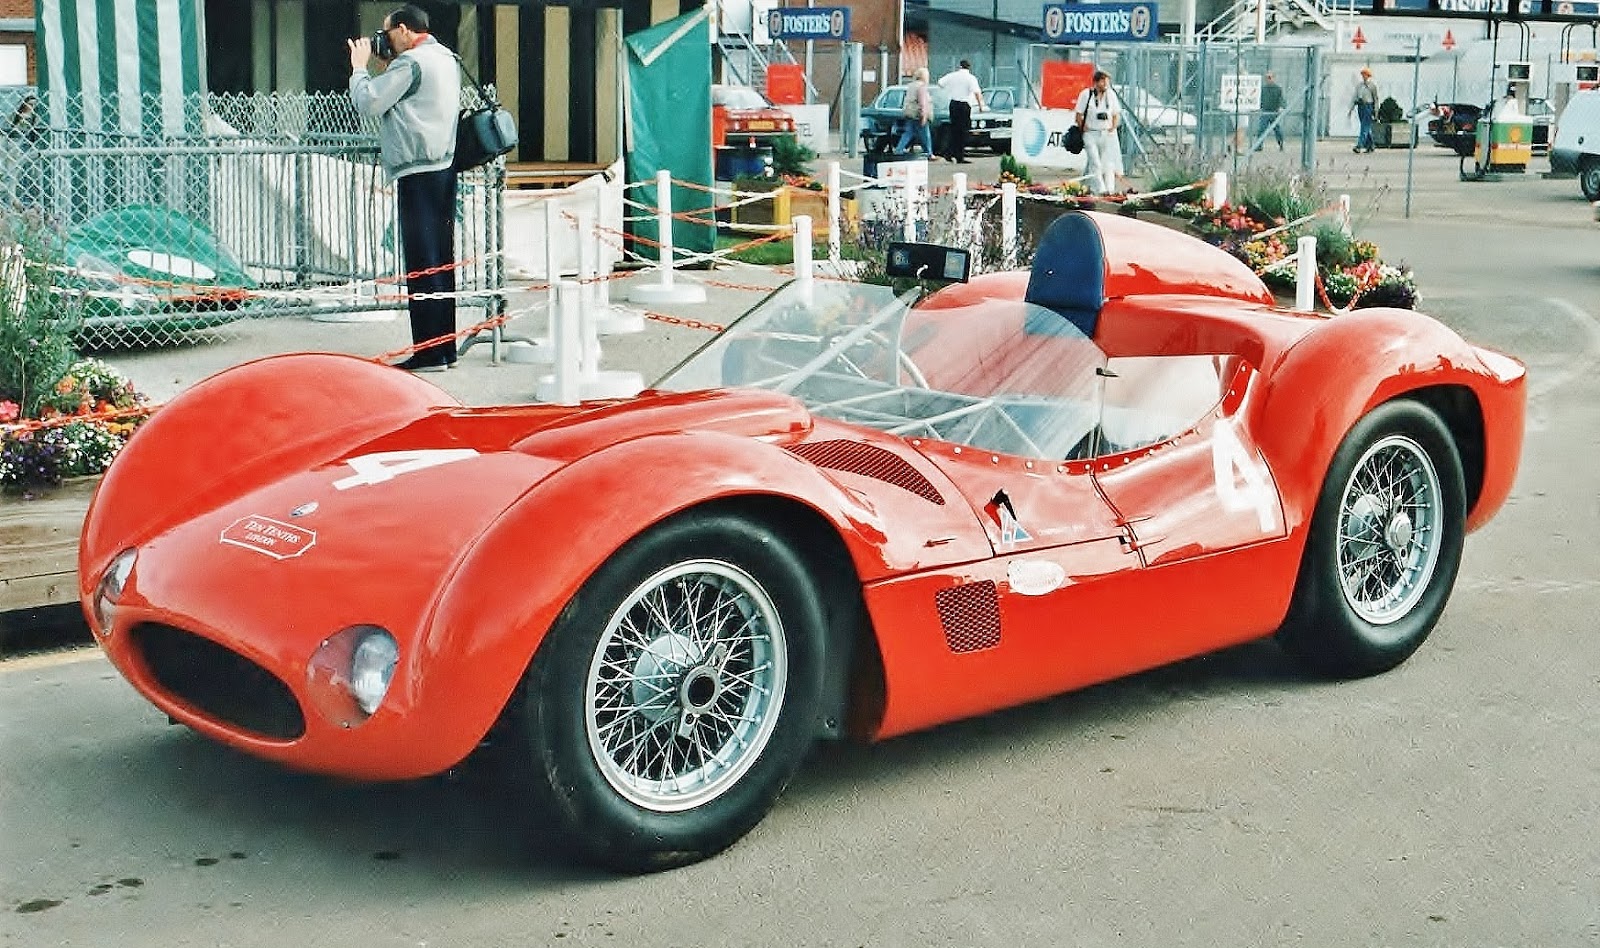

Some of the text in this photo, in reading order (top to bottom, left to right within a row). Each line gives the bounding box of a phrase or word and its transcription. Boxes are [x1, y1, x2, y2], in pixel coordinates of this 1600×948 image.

[783, 14, 831, 33] FOSTER'S
[1064, 9, 1131, 33] FOSTER'S
[1047, 131, 1065, 148] AT
[332, 448, 481, 491] 4
[1210, 418, 1277, 532] 4
[245, 532, 277, 546] LONDON
